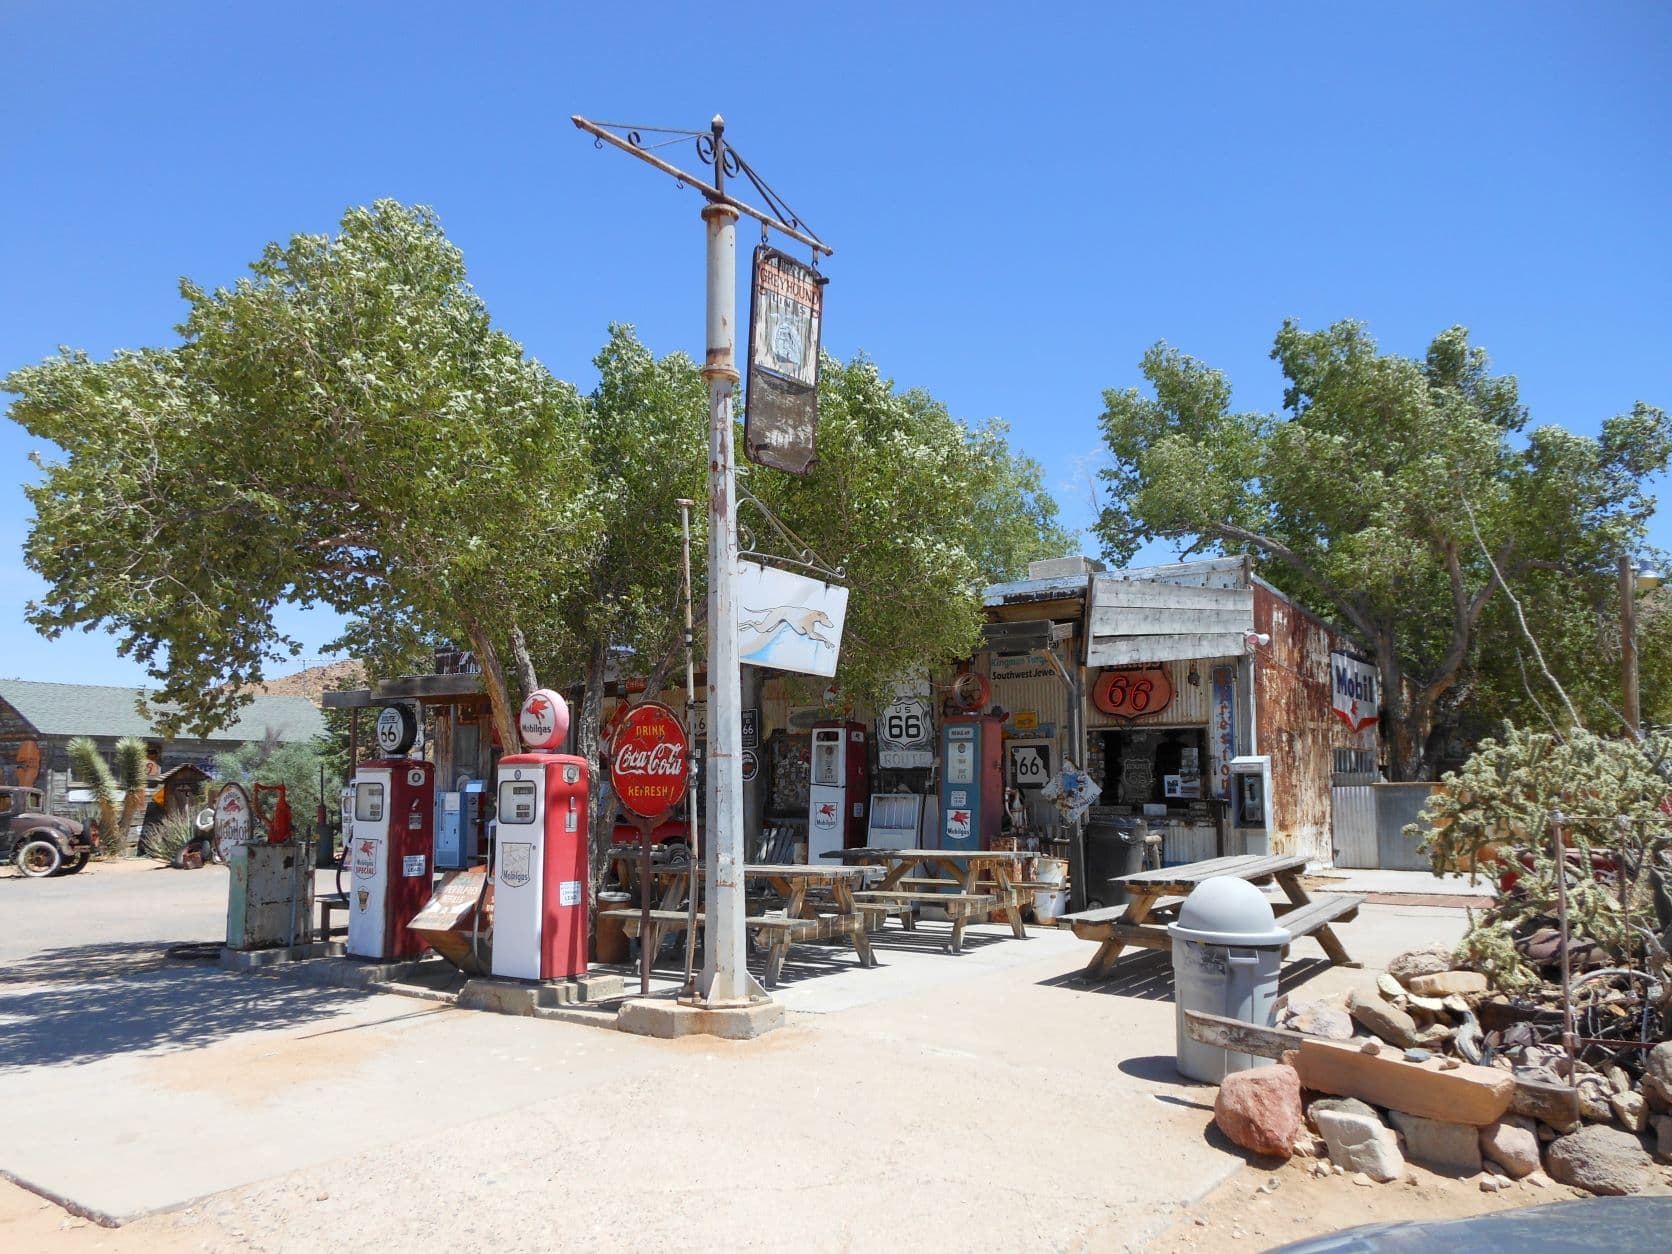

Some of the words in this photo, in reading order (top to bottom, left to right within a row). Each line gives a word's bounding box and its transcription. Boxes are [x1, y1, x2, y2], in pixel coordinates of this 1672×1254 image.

[759, 267, 820, 306] GREYHOUND
[768, 291, 807, 315] LINS
[992, 669, 1033, 681] Southwest
[1335, 664, 1375, 703] Mobil
[1106, 675, 1153, 712] 66
[380, 724, 397, 743] 66
[521, 724, 552, 735] Mobilgas
[635, 725, 665, 737] DRINK
[742, 724, 754, 735] 66
[888, 714, 921, 739] 66
[1217, 670, 1231, 790] Fireston
[615, 743, 683, 775] Coca-Cola
[1019, 757, 1040, 776] 66
[502, 869, 529, 882] Mobilgas
